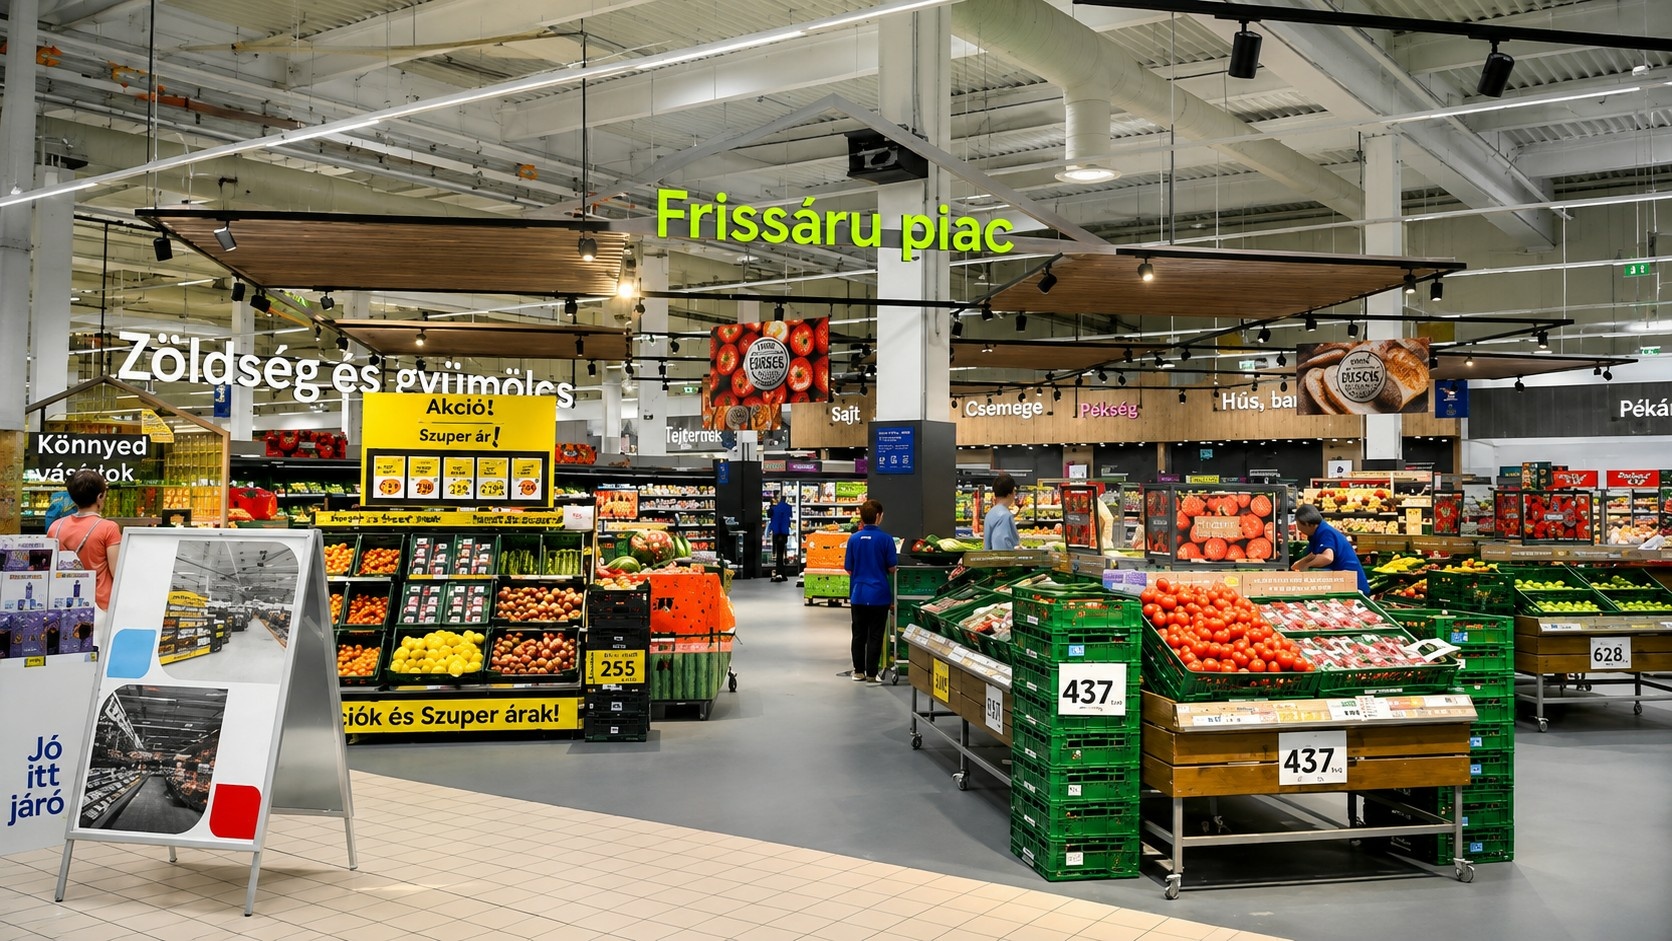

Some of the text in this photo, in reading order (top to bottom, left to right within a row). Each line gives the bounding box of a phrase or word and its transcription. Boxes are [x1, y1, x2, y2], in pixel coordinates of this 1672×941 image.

[656, 188, 1015, 262] Frissáru piac
[118, 331, 320, 403] Zöldség
[331, 352, 382, 394] és
[426, 397, 494, 416] Akció!
[831, 405, 860, 425] Sajt
[965, 400, 1043, 419] Csemege
[1080, 401, 1138, 419] Pékség
[1620, 398, 1672, 417] Péká
[38, 434, 147, 460] Könnyed
[419, 426, 501, 448] Szuper ár!
[1594, 647, 1622, 662] 628
[600, 660, 635, 677] 255
[1062, 679, 1113, 704] 437
[388, 706, 414, 725] és
[421, 706, 499, 729] Szuper
[505, 704, 559, 723] árak!
[27, 735, 62, 761] Jó
[1284, 748, 1334, 773] 437
[28, 763, 60, 788] itt
[7, 789, 64, 826] járó
